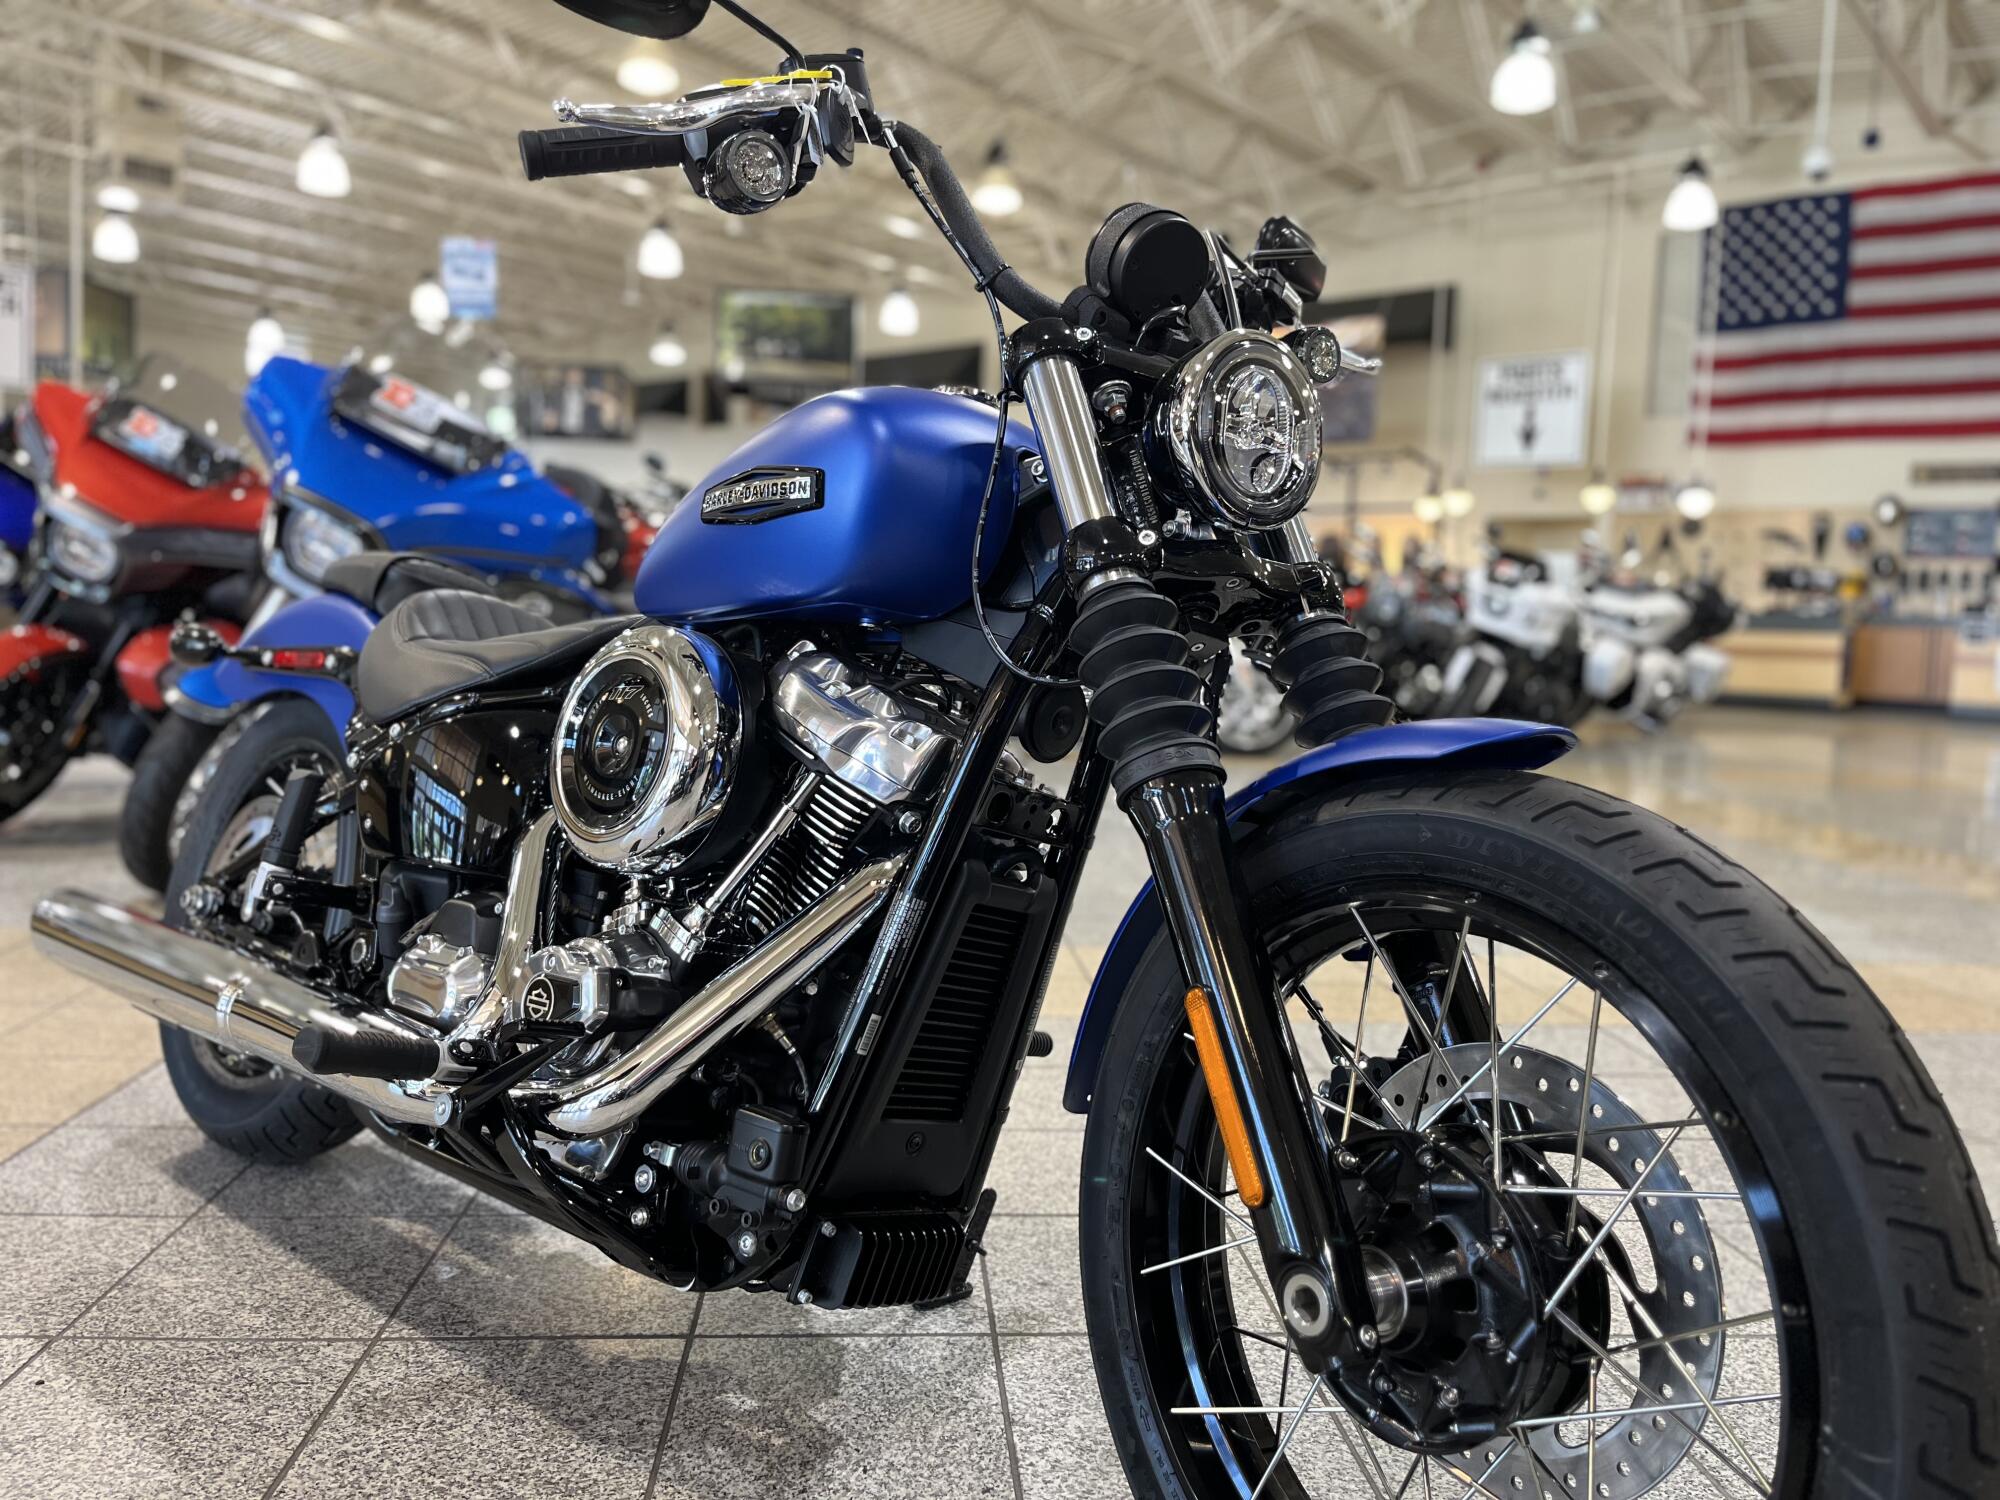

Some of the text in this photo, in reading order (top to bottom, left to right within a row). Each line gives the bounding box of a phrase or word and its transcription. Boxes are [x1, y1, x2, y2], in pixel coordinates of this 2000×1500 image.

[703, 480, 808, 511] HARLEY-DAVIDSON
[608, 684, 645, 701] 117
[583, 774, 639, 801] MILWAUKEE-EIGHT
[1448, 831, 1612, 912] DUNLOP
